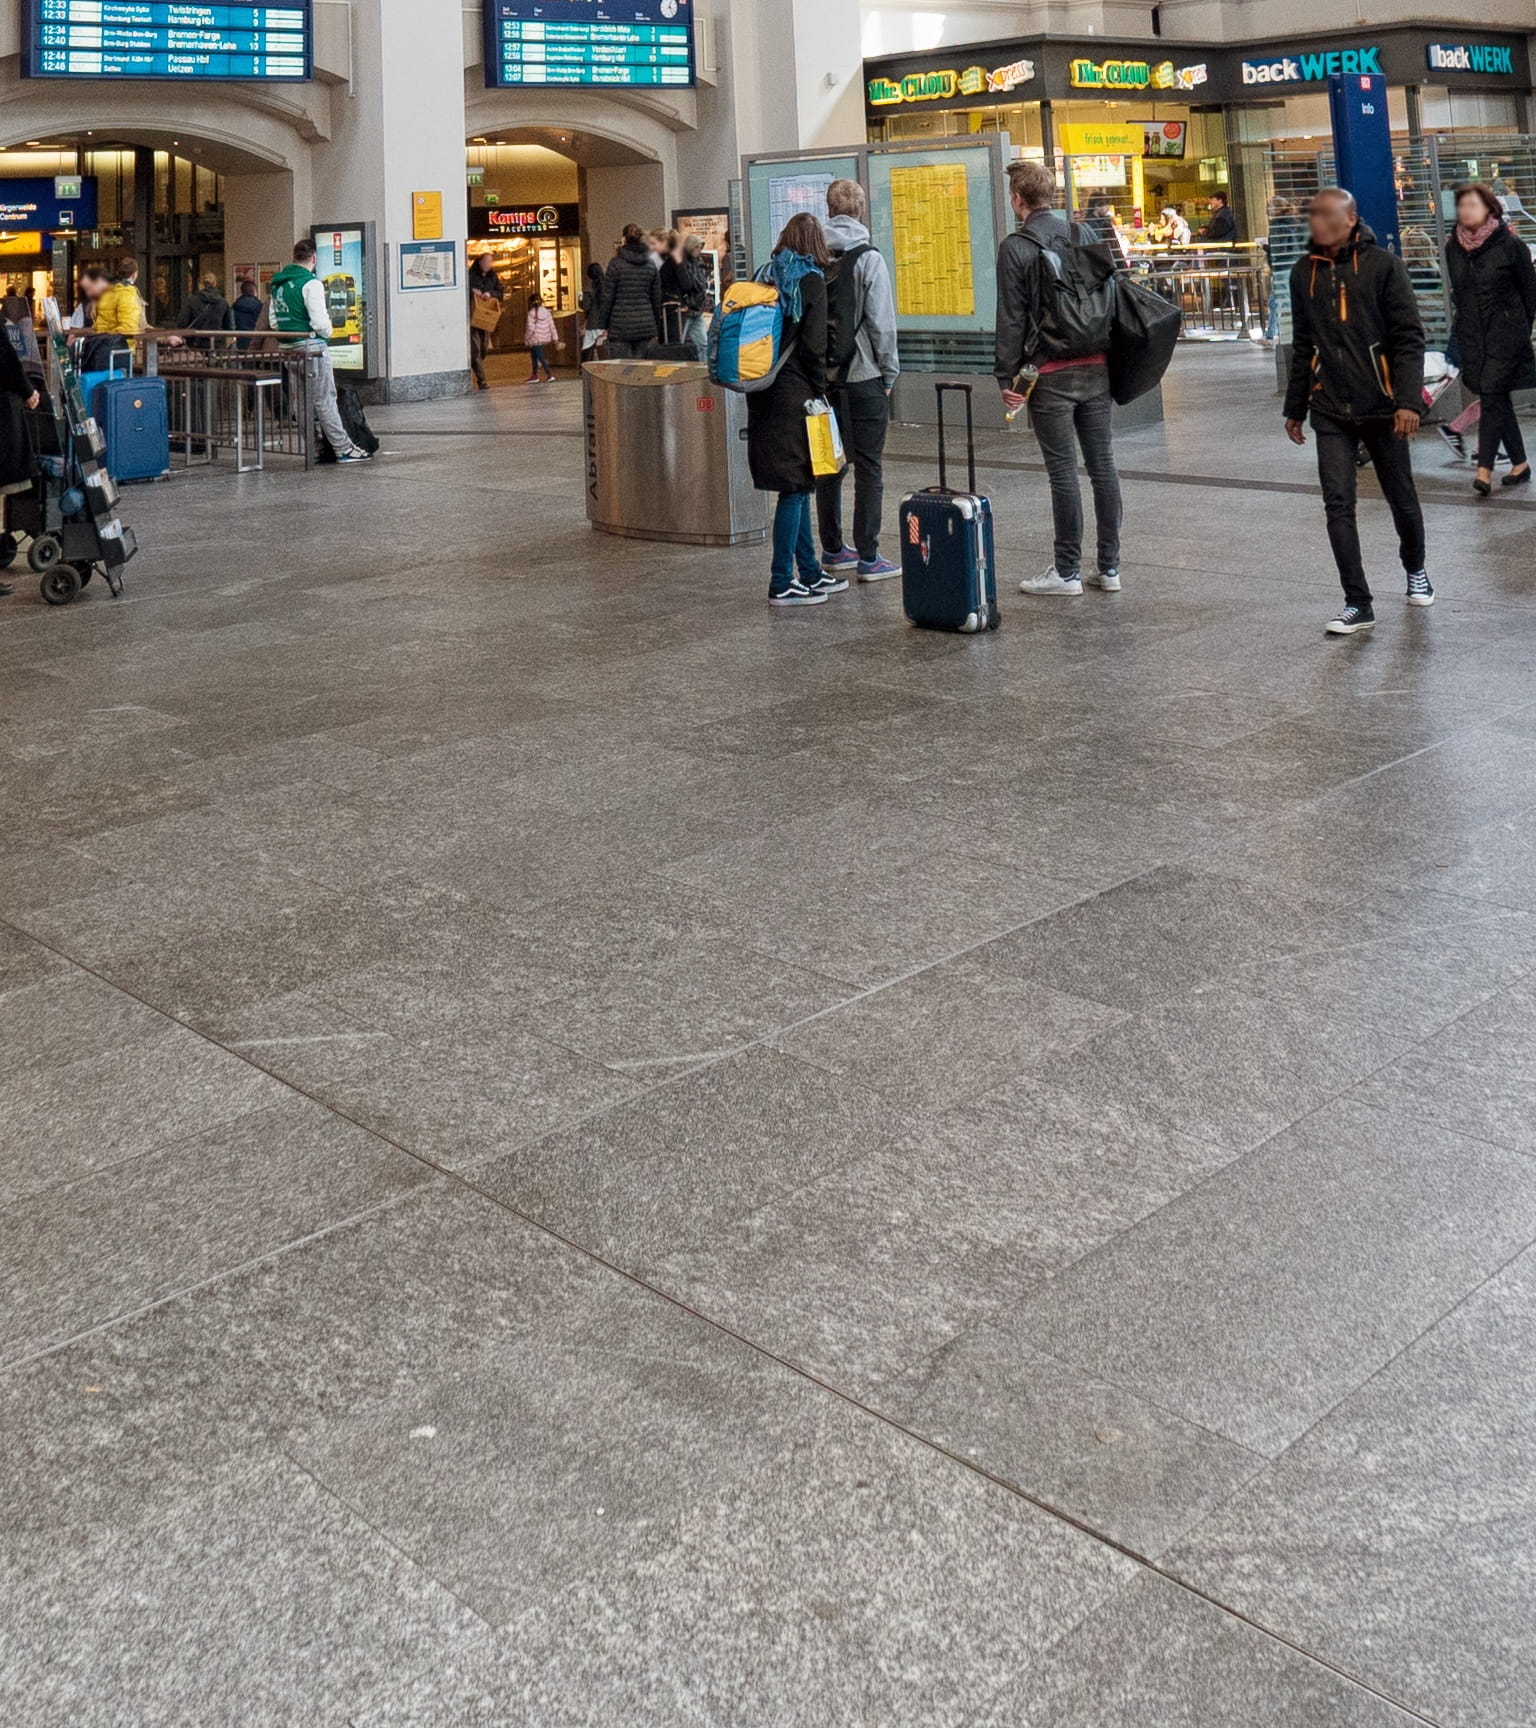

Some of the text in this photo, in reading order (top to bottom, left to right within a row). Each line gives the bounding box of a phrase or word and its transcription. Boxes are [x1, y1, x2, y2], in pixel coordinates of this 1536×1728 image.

[168, 15, 201, 26] Hamburg
[1361, 103, 1375, 115] Info
[488, 209, 537, 227] Kamps
[586, 414, 599, 502] Abfall
